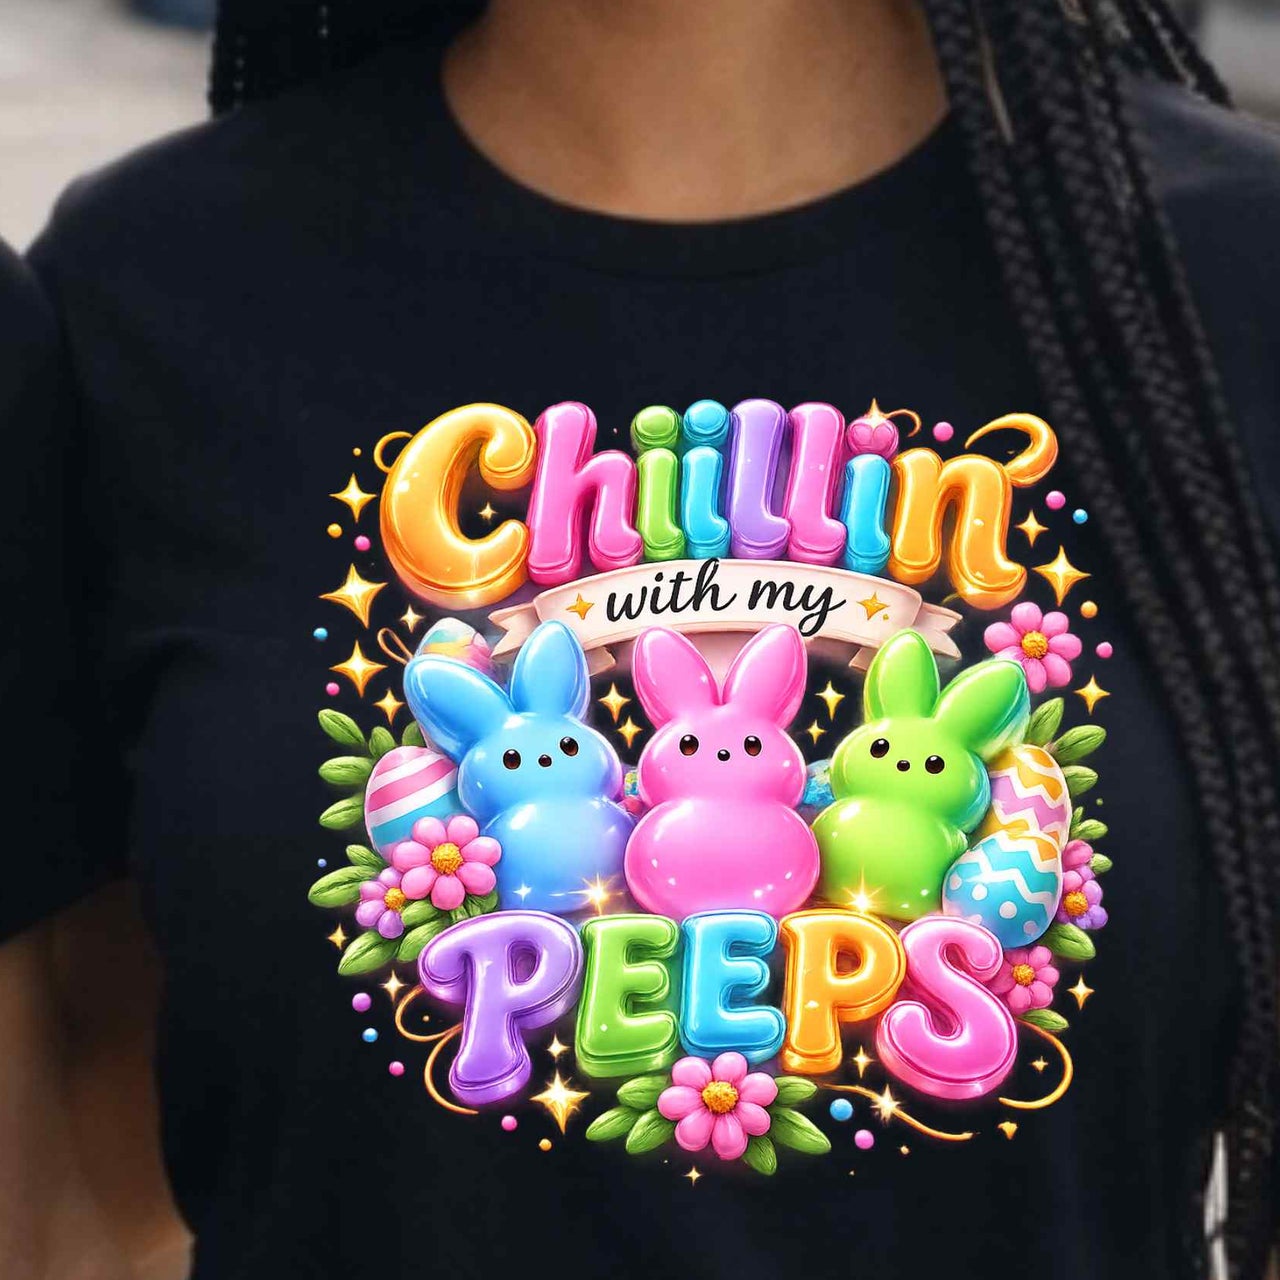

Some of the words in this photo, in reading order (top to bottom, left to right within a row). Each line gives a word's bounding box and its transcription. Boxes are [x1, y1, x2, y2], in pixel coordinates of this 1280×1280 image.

[606, 557, 736, 622] with
[747, 579, 847, 637] my
[418, 908, 1018, 1104] PEEPS
